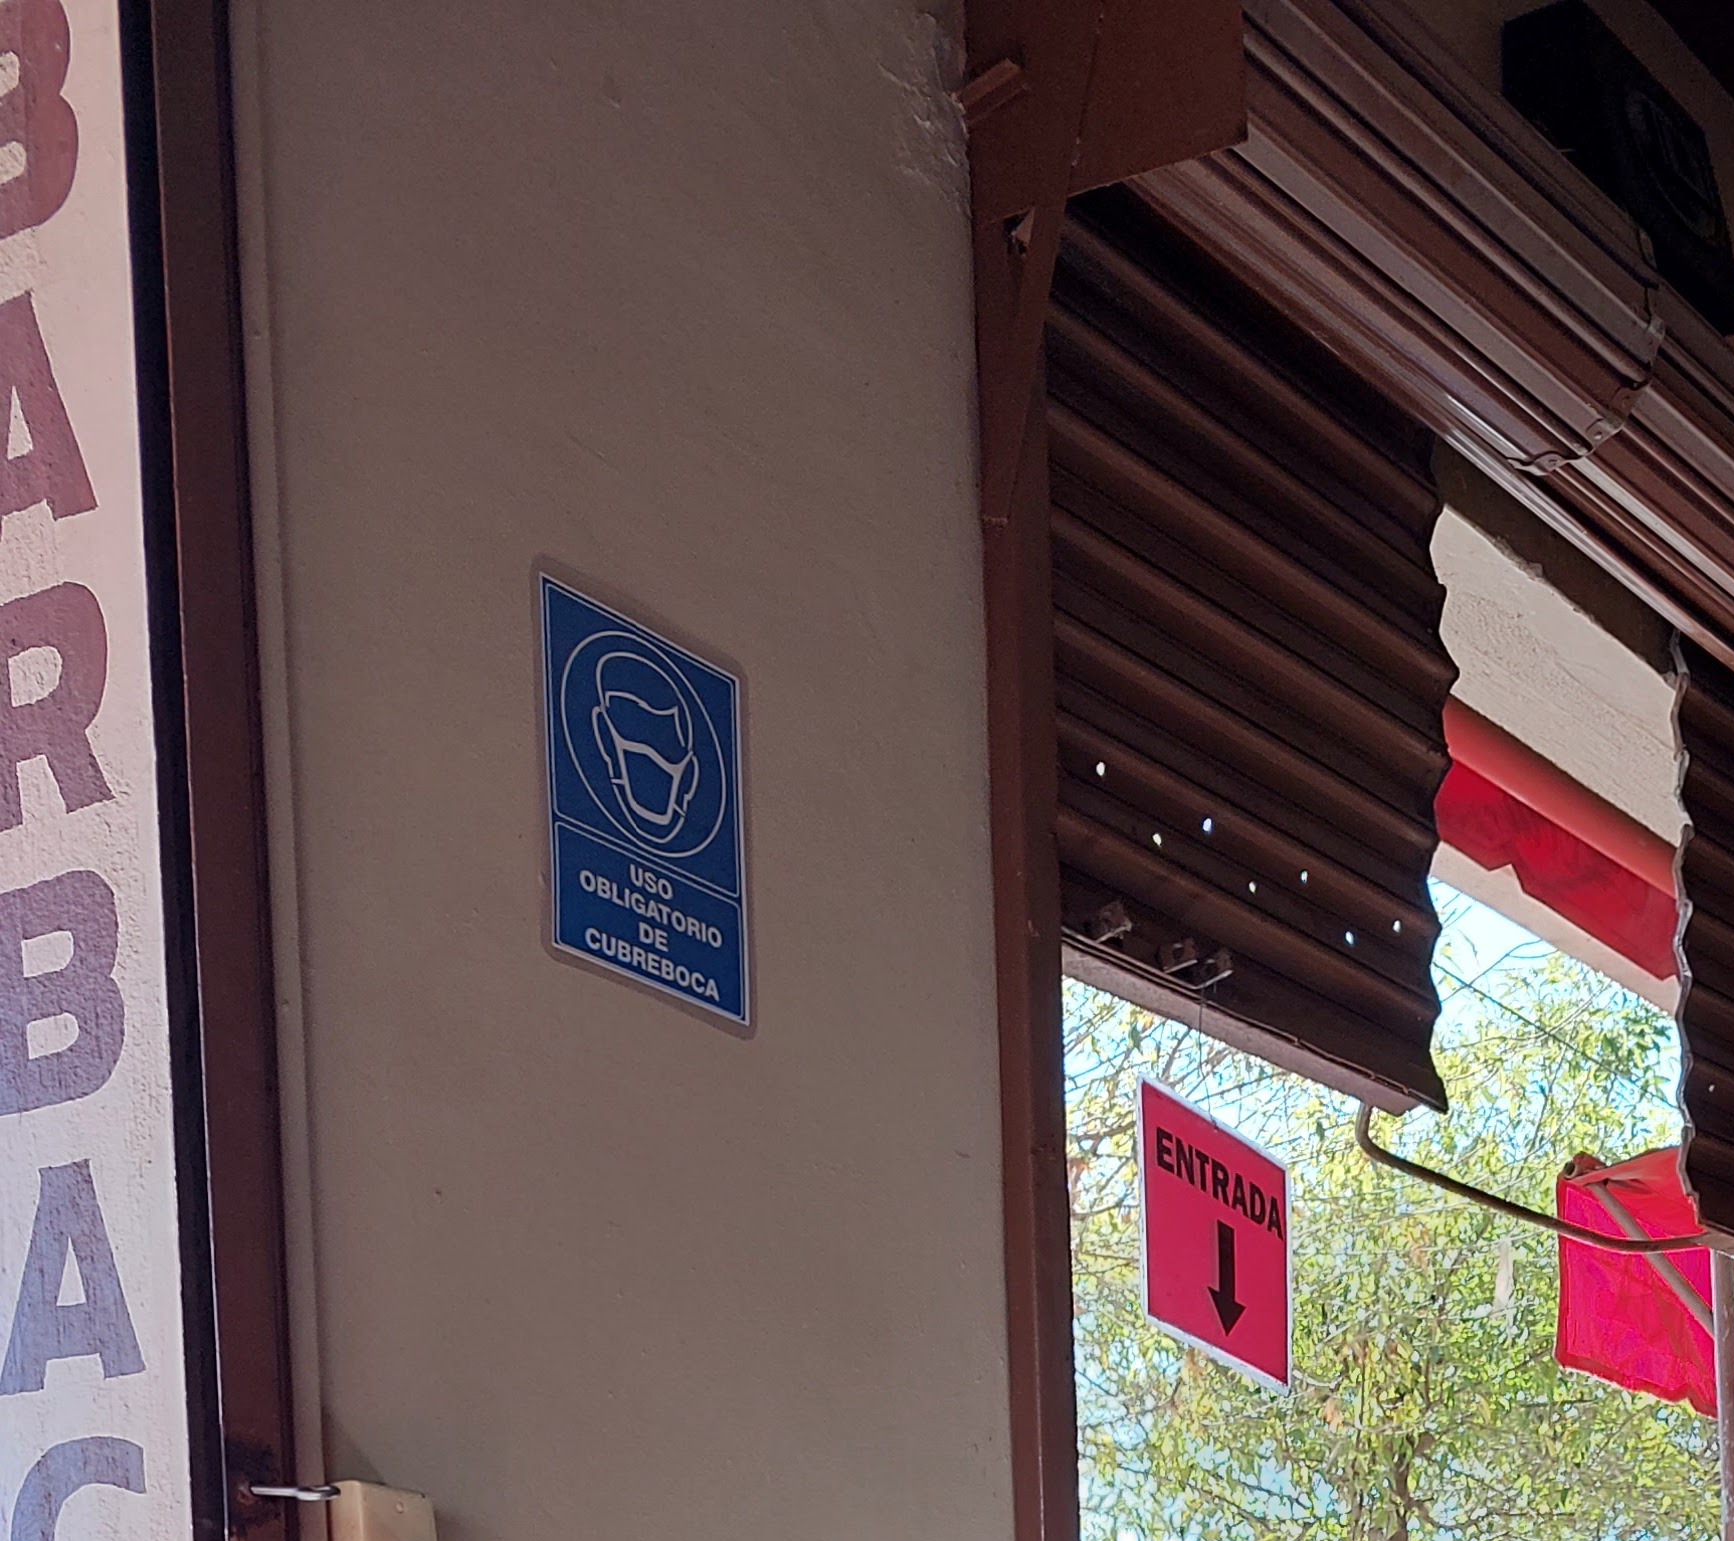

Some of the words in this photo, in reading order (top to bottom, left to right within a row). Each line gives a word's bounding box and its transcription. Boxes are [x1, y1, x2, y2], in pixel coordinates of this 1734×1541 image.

[579, 870, 723, 948] OBLIGATORIO
[629, 863, 673, 900] USO
[585, 927, 720, 1002] CUBREBOCA
[638, 921, 669, 952] DE
[1156, 1126, 1284, 1242] ENTRADA
